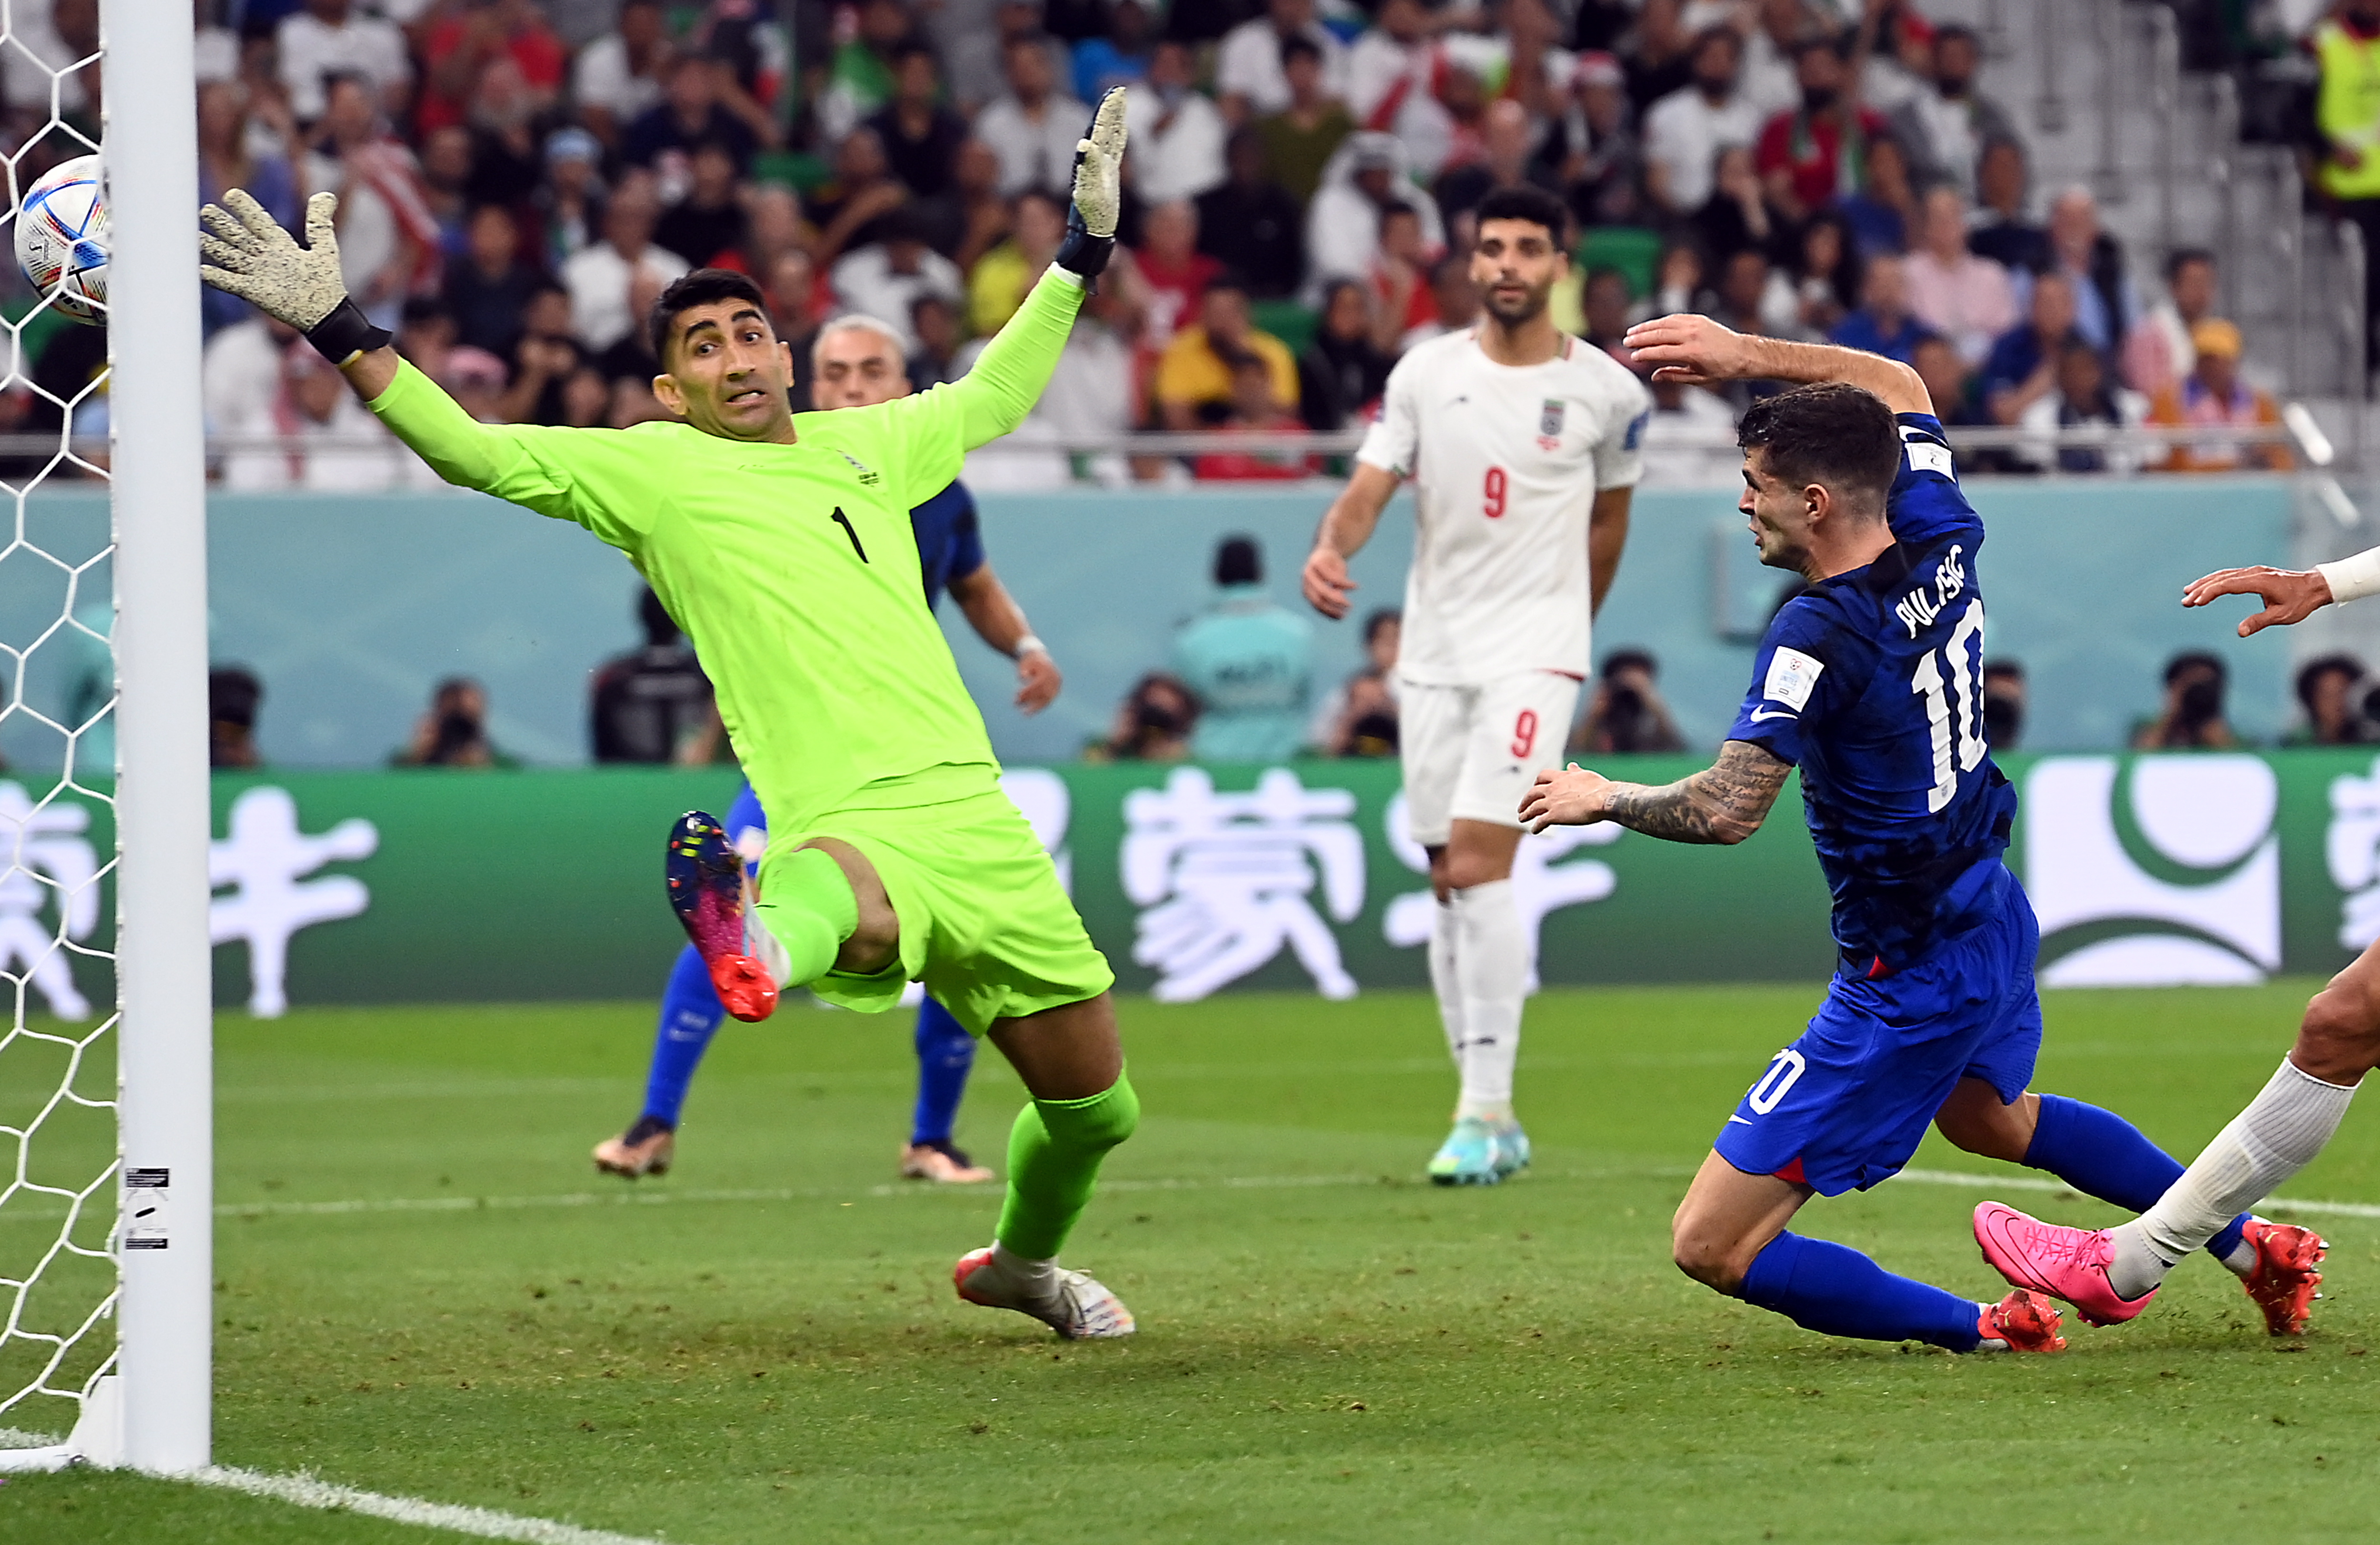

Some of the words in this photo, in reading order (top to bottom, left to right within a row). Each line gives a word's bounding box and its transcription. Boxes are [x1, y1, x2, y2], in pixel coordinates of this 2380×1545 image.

[1484, 465, 1508, 519] 9
[830, 506, 869, 564] 1
[1894, 544, 1965, 639] PULISIC
[1510, 709, 1538, 759] 9
[1911, 597, 1988, 814] 10
[1744, 1048, 1806, 1116] 0
